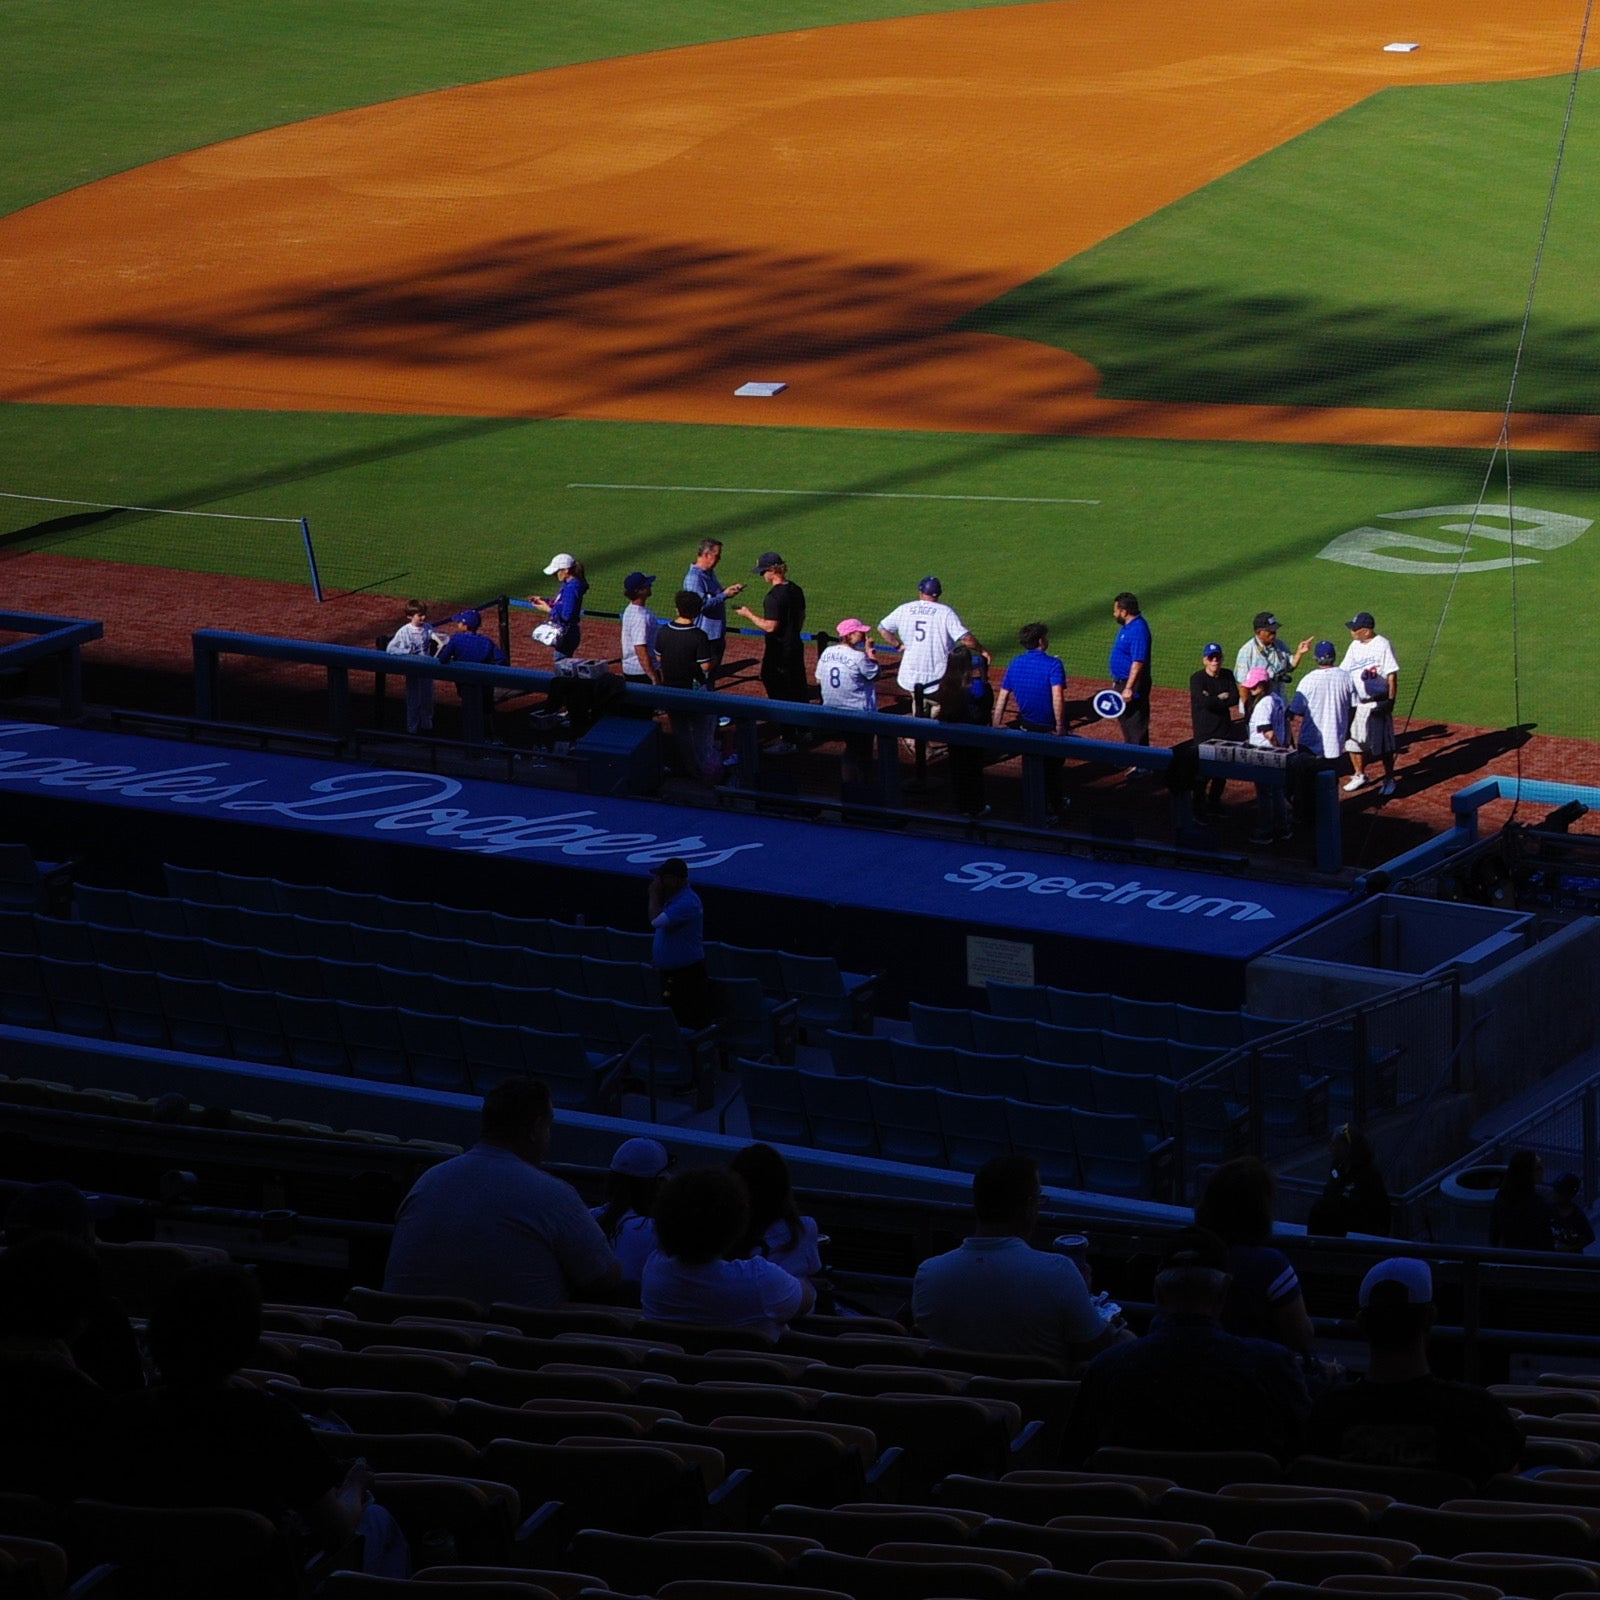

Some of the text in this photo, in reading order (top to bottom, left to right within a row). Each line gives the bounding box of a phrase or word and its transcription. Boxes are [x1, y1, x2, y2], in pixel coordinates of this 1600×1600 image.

[915, 620, 927, 642] 5
[830, 666, 841, 689] 8
[223, 769, 764, 871] Dodgers
[942, 860, 1257, 922] Spectrum
